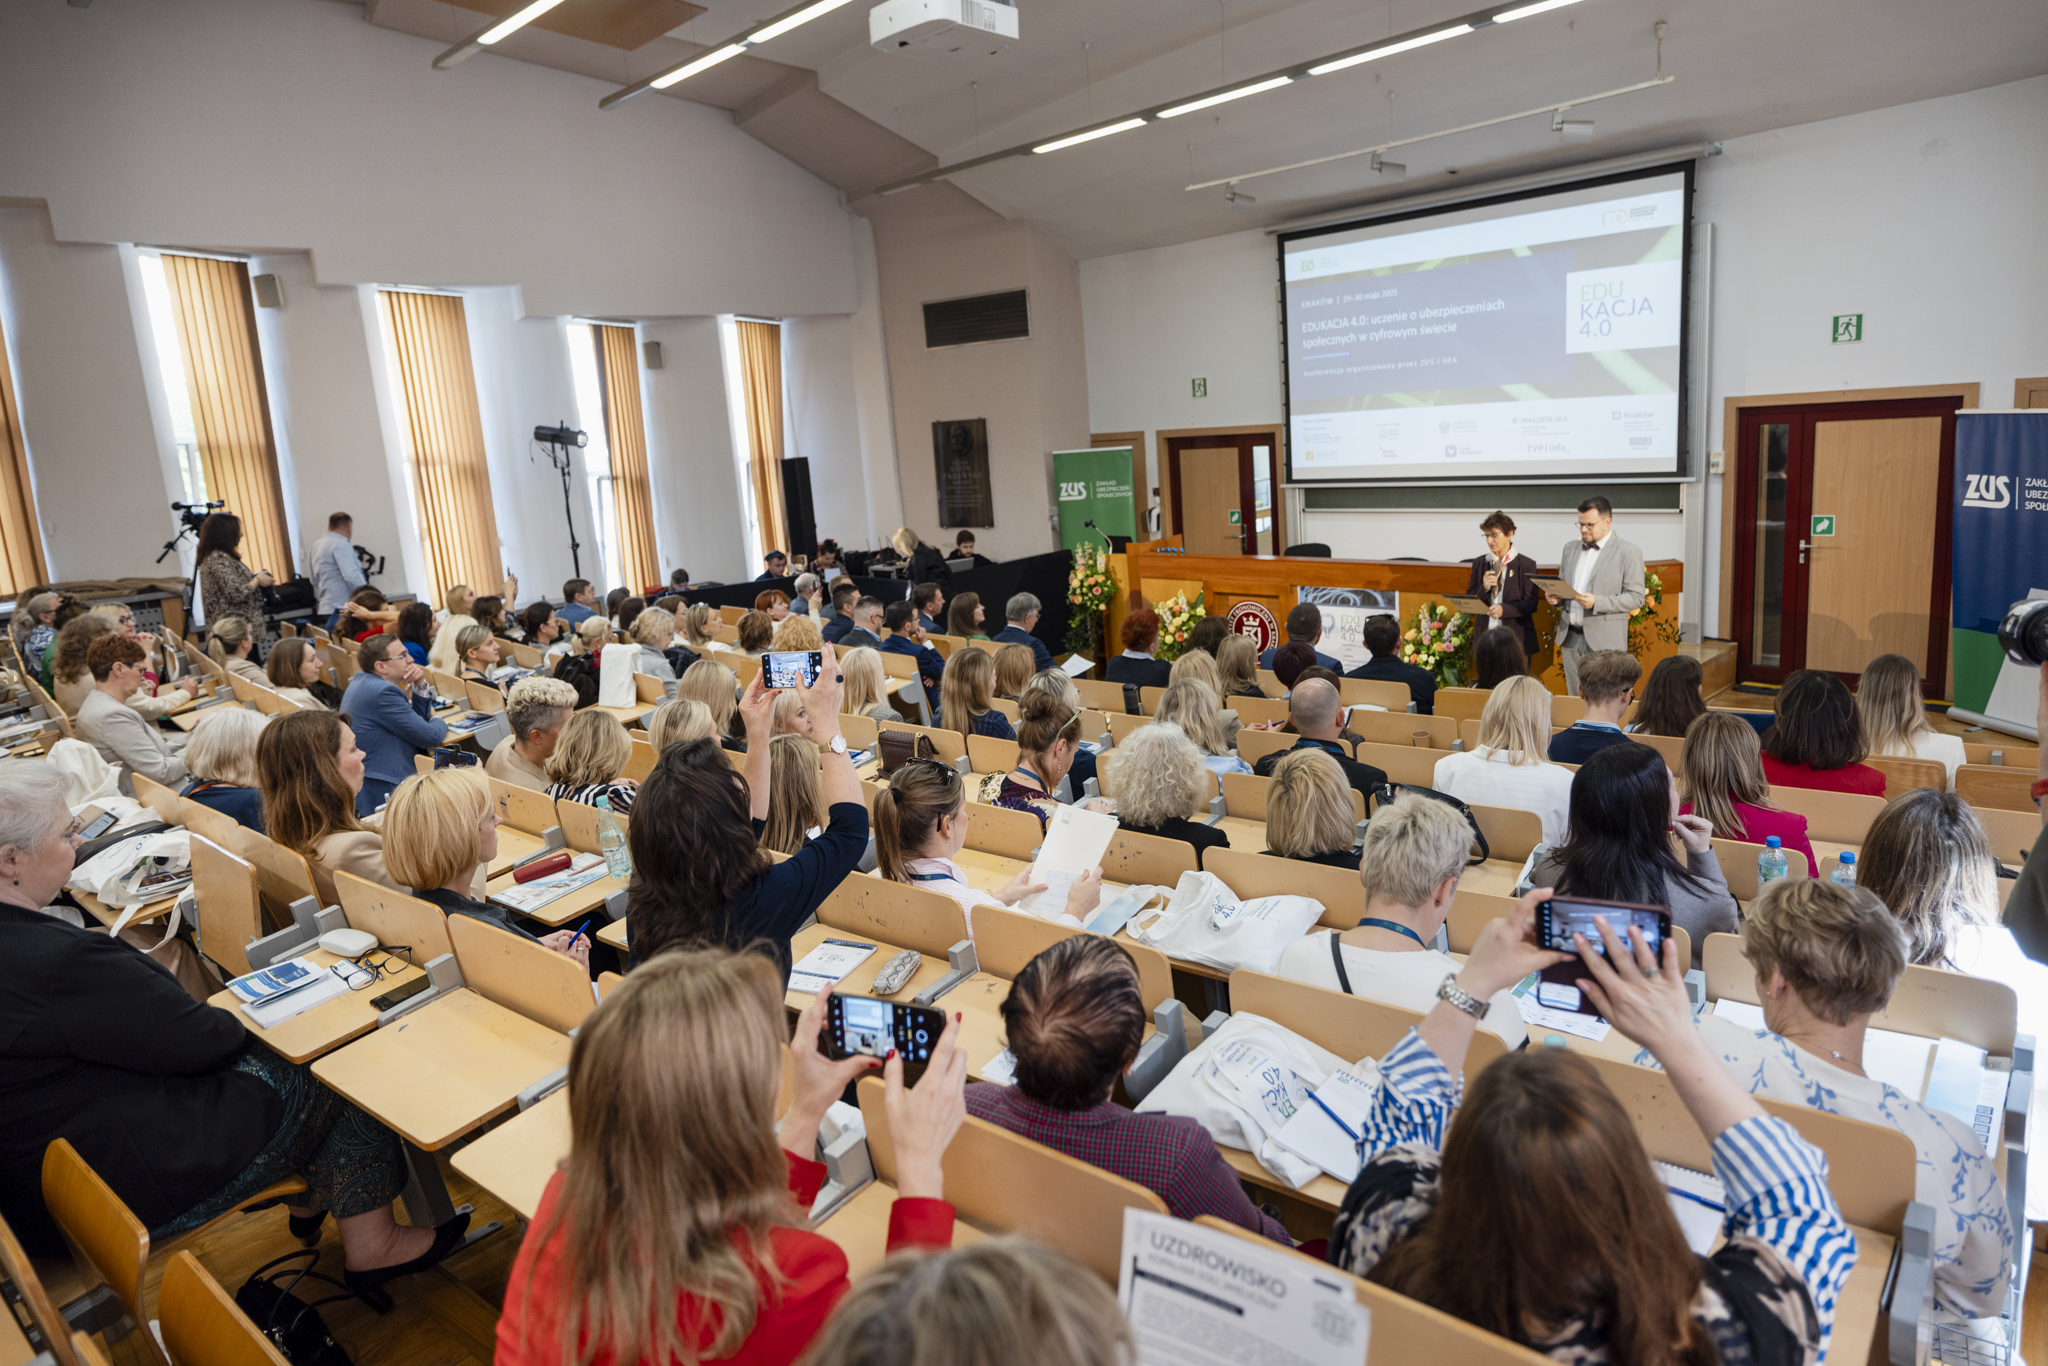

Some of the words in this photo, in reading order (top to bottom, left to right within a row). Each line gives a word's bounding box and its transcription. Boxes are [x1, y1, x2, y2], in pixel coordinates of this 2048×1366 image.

[1301, 297, 1334, 309] KRAKÓW
[1364, 291, 1380, 302] maja
[1381, 288, 1398, 299] 2025
[1580, 281, 1624, 302] EDU
[1302, 317, 1350, 333] EDUKACJA
[1350, 314, 1369, 327] 4.0:
[1371, 311, 1408, 325] uczenie
[1410, 311, 1417, 320] o
[1419, 298, 1505, 319] ubezpieczeniach
[1580, 297, 1654, 321] KACJA
[1302, 333, 1357, 349] społecznych
[1358, 332, 1368, 342] w
[1369, 325, 1418, 343] cyfrowym
[1419, 321, 1457, 336] świecie
[1579, 319, 1612, 338] 4.0
[1303, 366, 1344, 377] konferencja
[1345, 362, 1395, 374] organizowana
[1397, 360, 1418, 370] przez
[1420, 358, 1435, 367] ZUS
[1442, 356, 1458, 365] UEK
[1521, 415, 1568, 424] MAŁOPOLSKA
[1624, 410, 1655, 419] Kraków
[1527, 444, 1544, 453] TVP
[1059, 481, 1087, 502] ZUS
[1961, 473, 2011, 509] ZUS
[2025, 501, 2048, 512] SPOŁ
[1340, 614, 1360, 624] EDU
[1340, 624, 1362, 634] KAC
[1340, 632, 1356, 642] 4.0
[1150, 1229, 1288, 1299] UZDROWISKO
